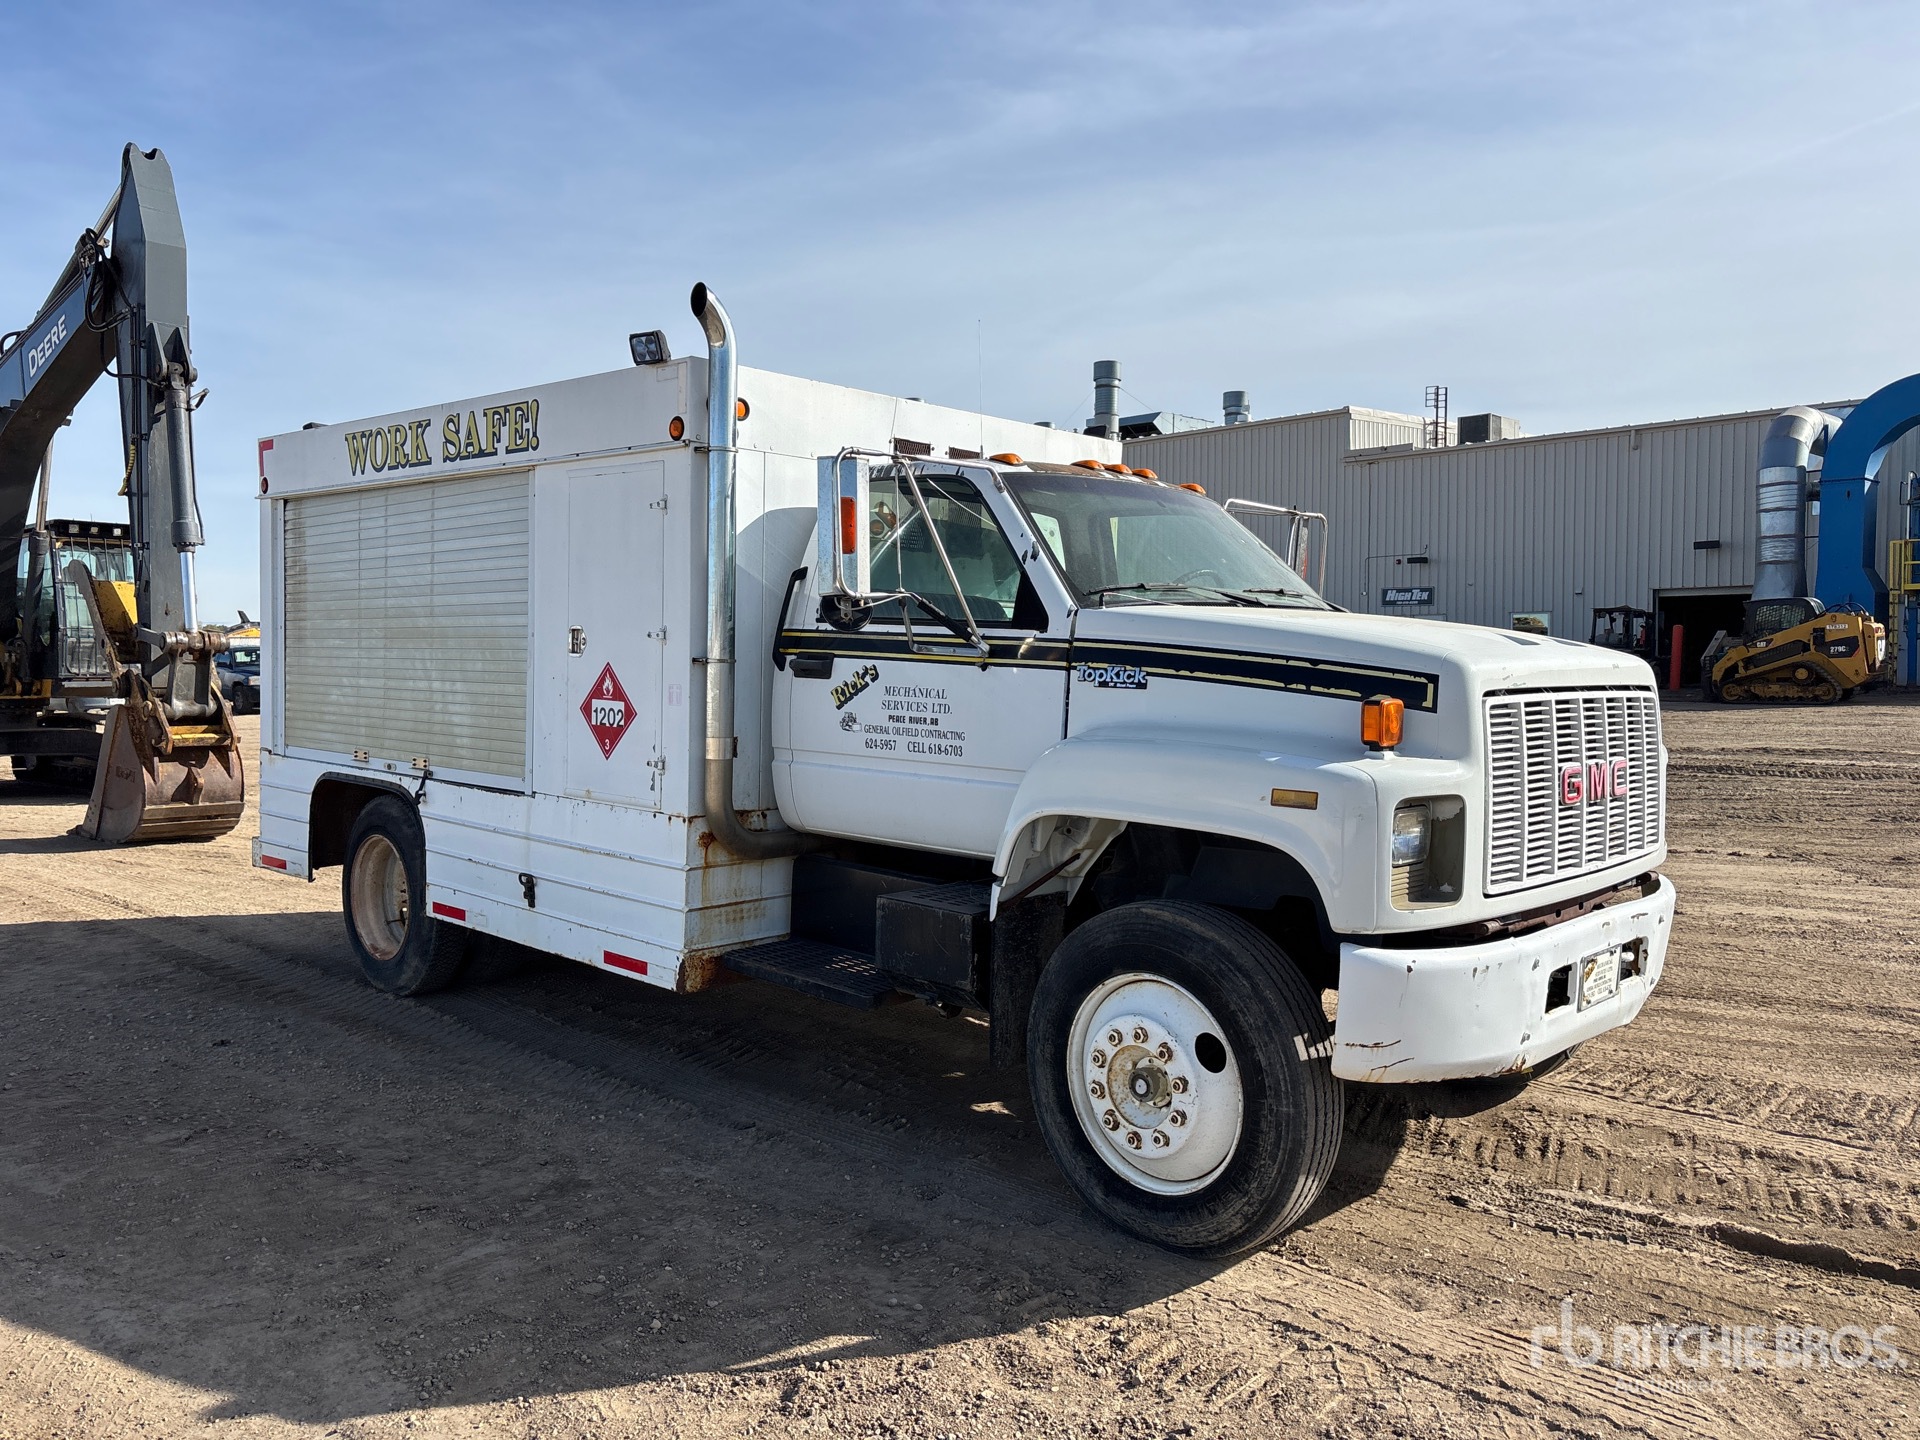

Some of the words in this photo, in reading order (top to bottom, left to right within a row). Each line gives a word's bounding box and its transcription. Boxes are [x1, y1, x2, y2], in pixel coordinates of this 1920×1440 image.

[28, 314, 67, 378] DEERE
[345, 418, 432, 476] WORK
[442, 399, 540, 463] SAFE!
[830, 664, 879, 710] Rick's
[1076, 665, 1147, 687] TopKick
[593, 706, 624, 728] 1202
[881, 700, 928, 713] SERVICES
[931, 702, 953, 715] LTD.
[888, 714, 906, 724] PEACE
[864, 724, 891, 736] GENERAL
[892, 726, 919, 738] OILFIELD
[920, 728, 966, 742] CONTRACTING
[604, 739, 610, 750] 3
[864, 738, 897, 751] 624-5957
[907, 741, 926, 754] CELL
[928, 743, 963, 758] 618-6703
[1560, 760, 1628, 806] GMC
